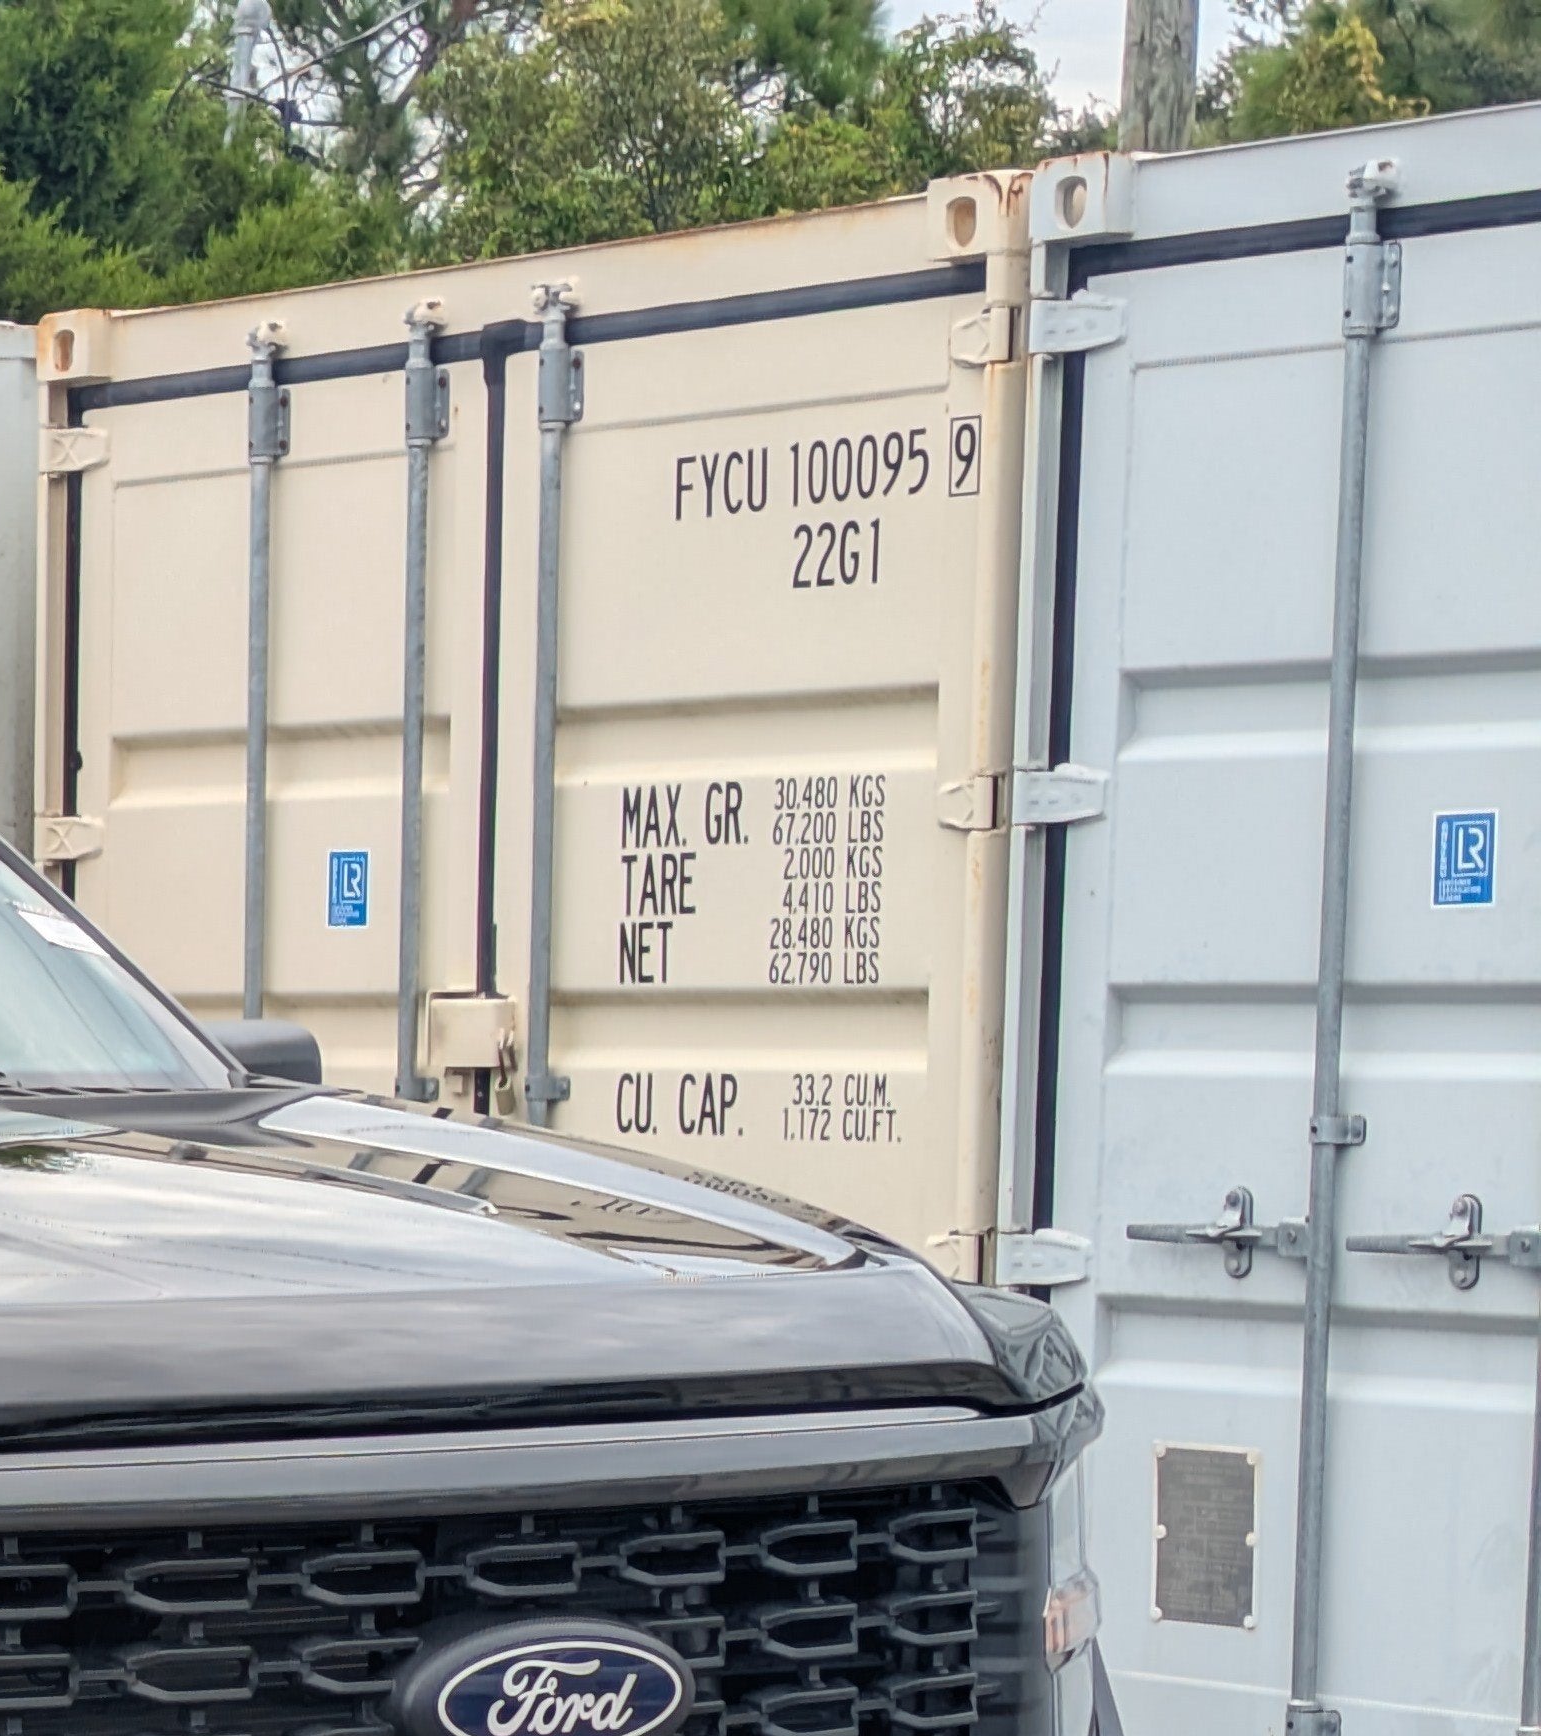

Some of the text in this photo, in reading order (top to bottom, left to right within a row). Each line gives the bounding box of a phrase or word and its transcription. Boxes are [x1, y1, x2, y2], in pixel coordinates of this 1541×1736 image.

[674, 423, 977, 521] FYCU 100095 9
[792, 518, 880, 588] 22G1
[621, 774, 886, 848] MAX. GR. 30.480 KGS
[772, 809, 884, 845] 67.200 LBS
[621, 845, 883, 917] TARE 2.000 KGS
[782, 880, 882, 915] 4.410 LBS
[619, 916, 880, 984] NET 28.480 KGS
[768, 951, 880, 985] 62.790 LBS
[617, 1072, 658, 1135] CU.
[679, 1072, 744, 1136] CAP.
[792, 1073, 833, 1107] 33.2
[783, 1108, 831, 1142] 1.172
